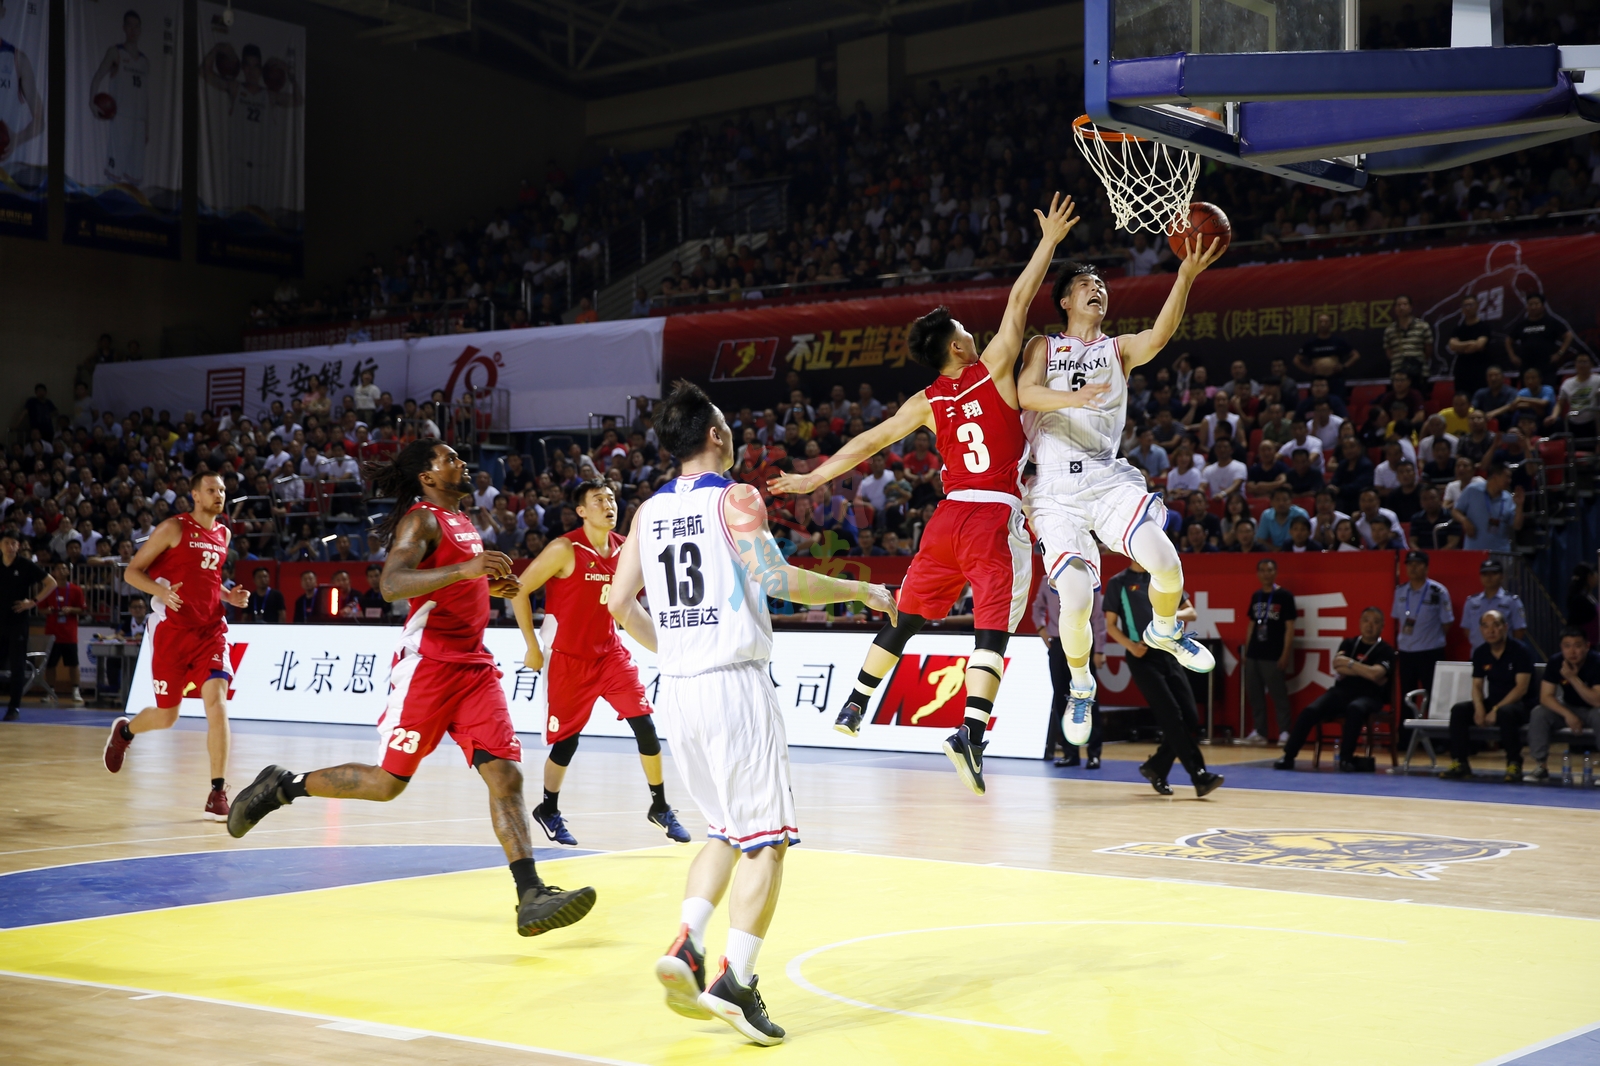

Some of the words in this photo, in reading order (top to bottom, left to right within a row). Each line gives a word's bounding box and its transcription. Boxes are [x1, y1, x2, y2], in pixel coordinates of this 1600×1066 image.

[246, 108, 261, 123] 22
[1476, 285, 1505, 322] 23
[956, 422, 991, 474] 3
[201, 550, 220, 571] 32
[584, 572, 610, 582] CHONG
[658, 542, 705, 607] 13
[599, 583, 613, 605] 8
[153, 679, 169, 696] 32
[548, 715, 560, 733] 8
[388, 727, 422, 754] 23
